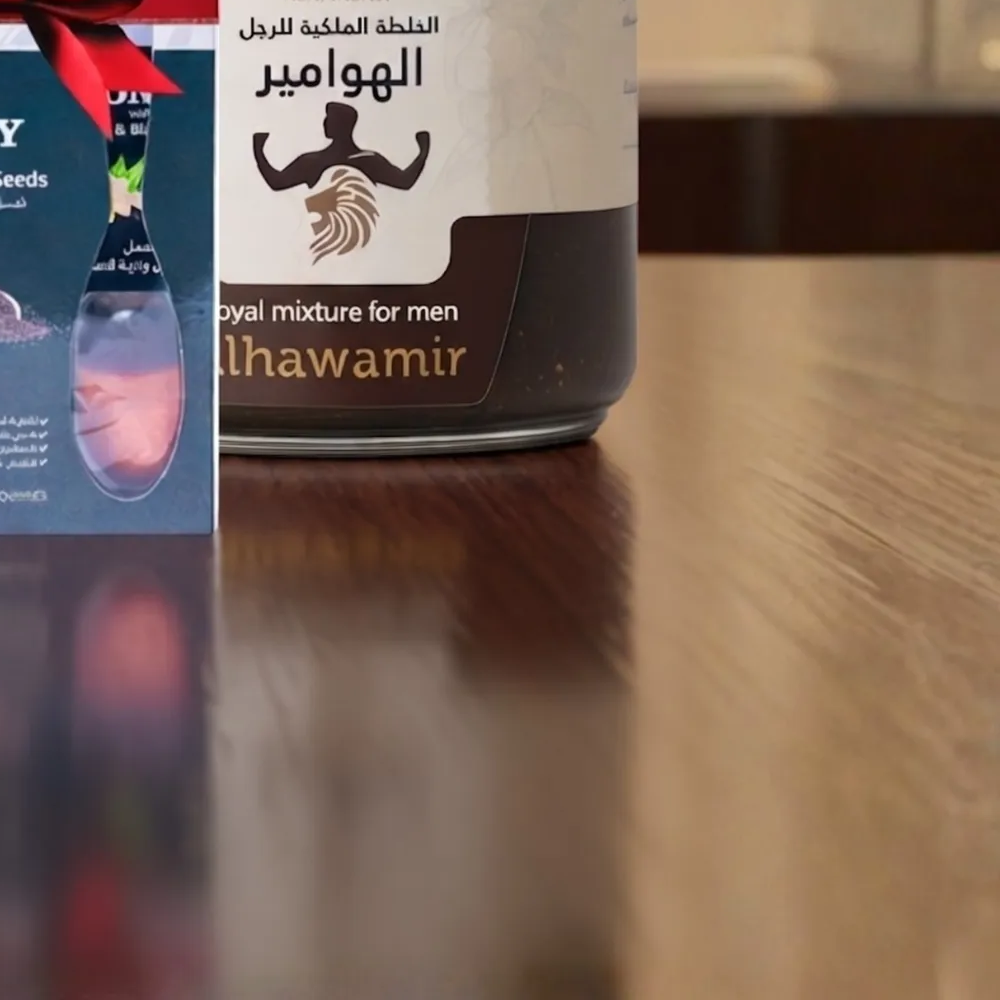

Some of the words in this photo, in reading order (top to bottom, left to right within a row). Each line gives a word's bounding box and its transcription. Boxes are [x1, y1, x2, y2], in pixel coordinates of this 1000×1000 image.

[239, 16, 293, 41] للرجل
[300, 16, 368, 39] الملكية
[375, 15, 439, 36] الخلطة
[255, 46, 422, 103] الهوامير
[218, 299, 264, 325] oyal
[272, 299, 362, 323] mixture
[369, 300, 401, 323] for
[407, 304, 459, 322] men
[218, 333, 468, 378] lhawamir
